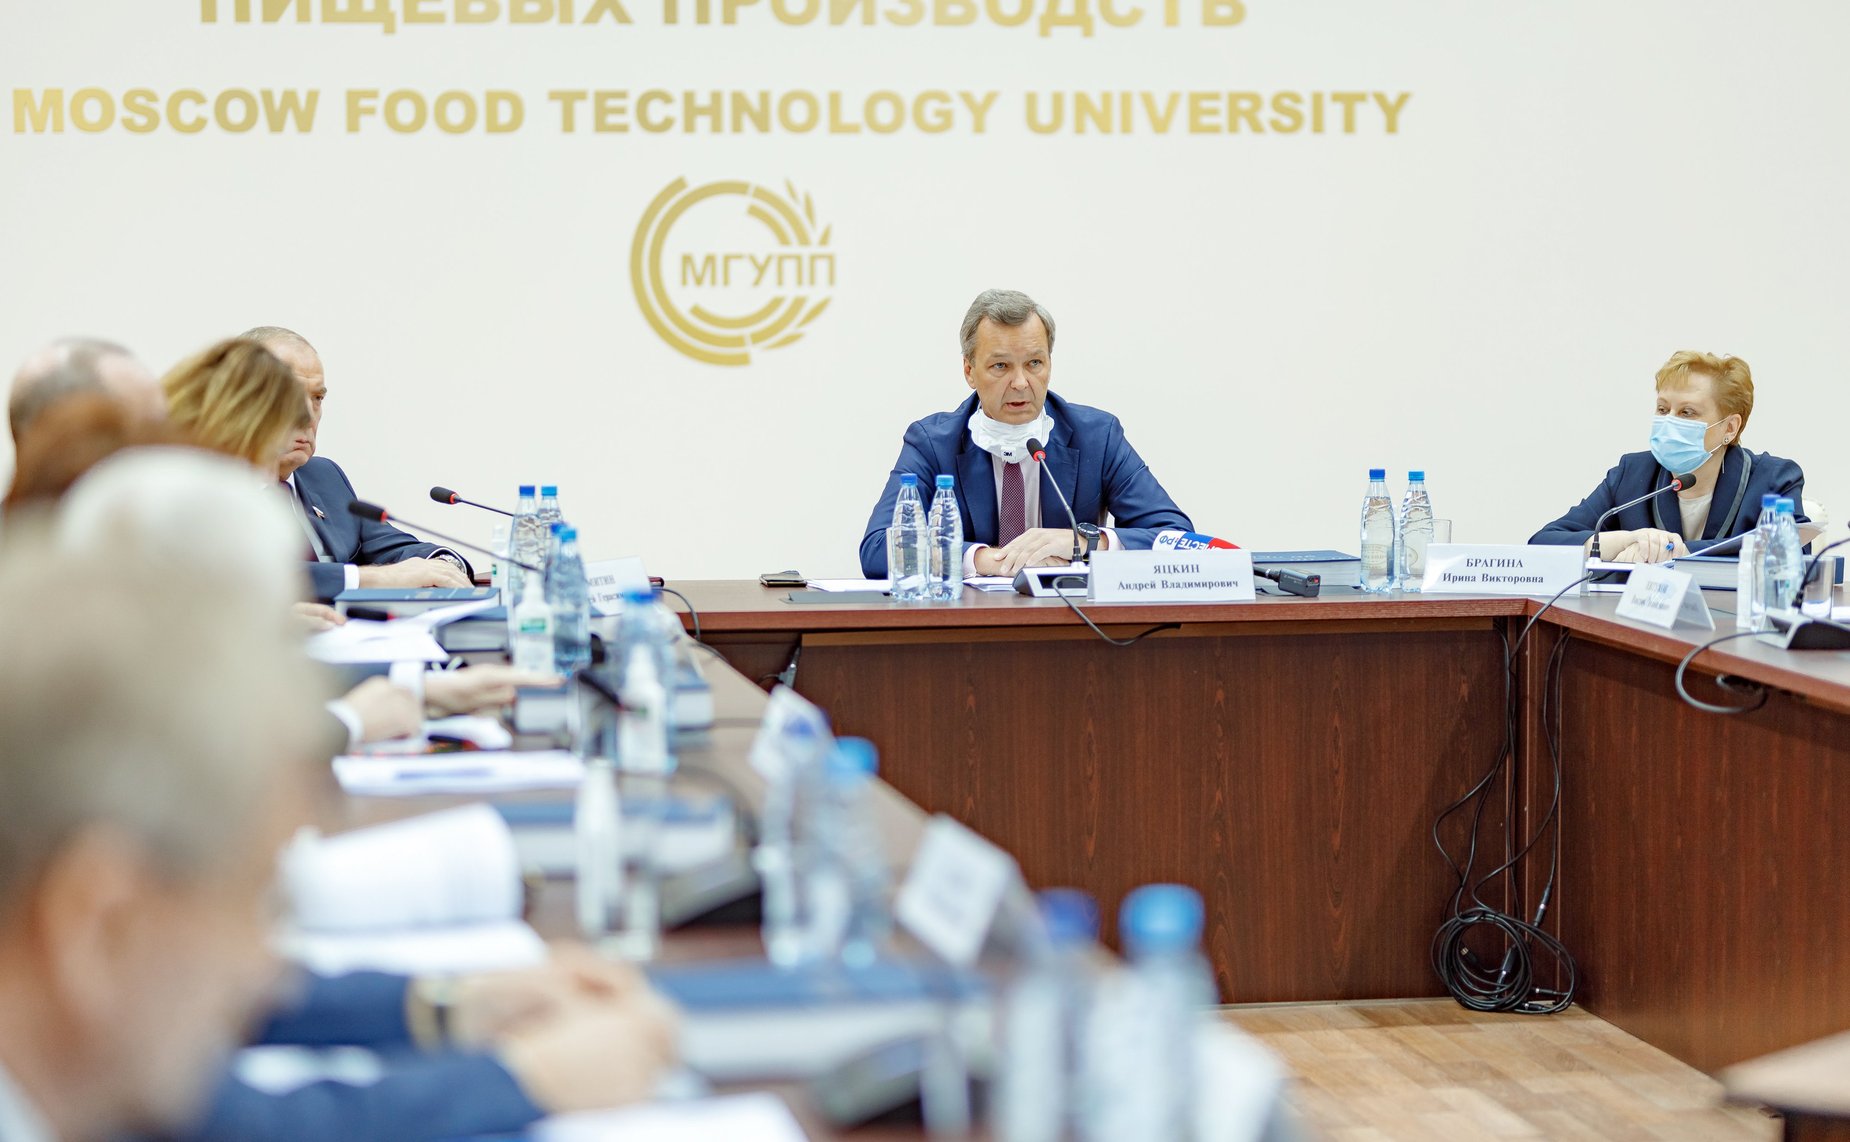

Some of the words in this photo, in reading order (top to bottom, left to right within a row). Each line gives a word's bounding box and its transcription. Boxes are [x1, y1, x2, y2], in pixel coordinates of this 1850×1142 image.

[12, 87, 321, 135] MOSCOW
[344, 89, 526, 135] FOOD
[547, 89, 999, 135] TECHNOLOGY
[1024, 90, 1413, 135] UNIVERSITY
[681, 253, 836, 287] МГУПП
[1466, 558, 1523, 568] БРАГИНА
[1153, 564, 1200, 575] ЯЦКИН
[1118, 580, 1157, 591] Андрей
[1161, 579, 1239, 590] Владимирович
[1443, 573, 1477, 584] Ирина
[1481, 573, 1544, 585] Викторовна
